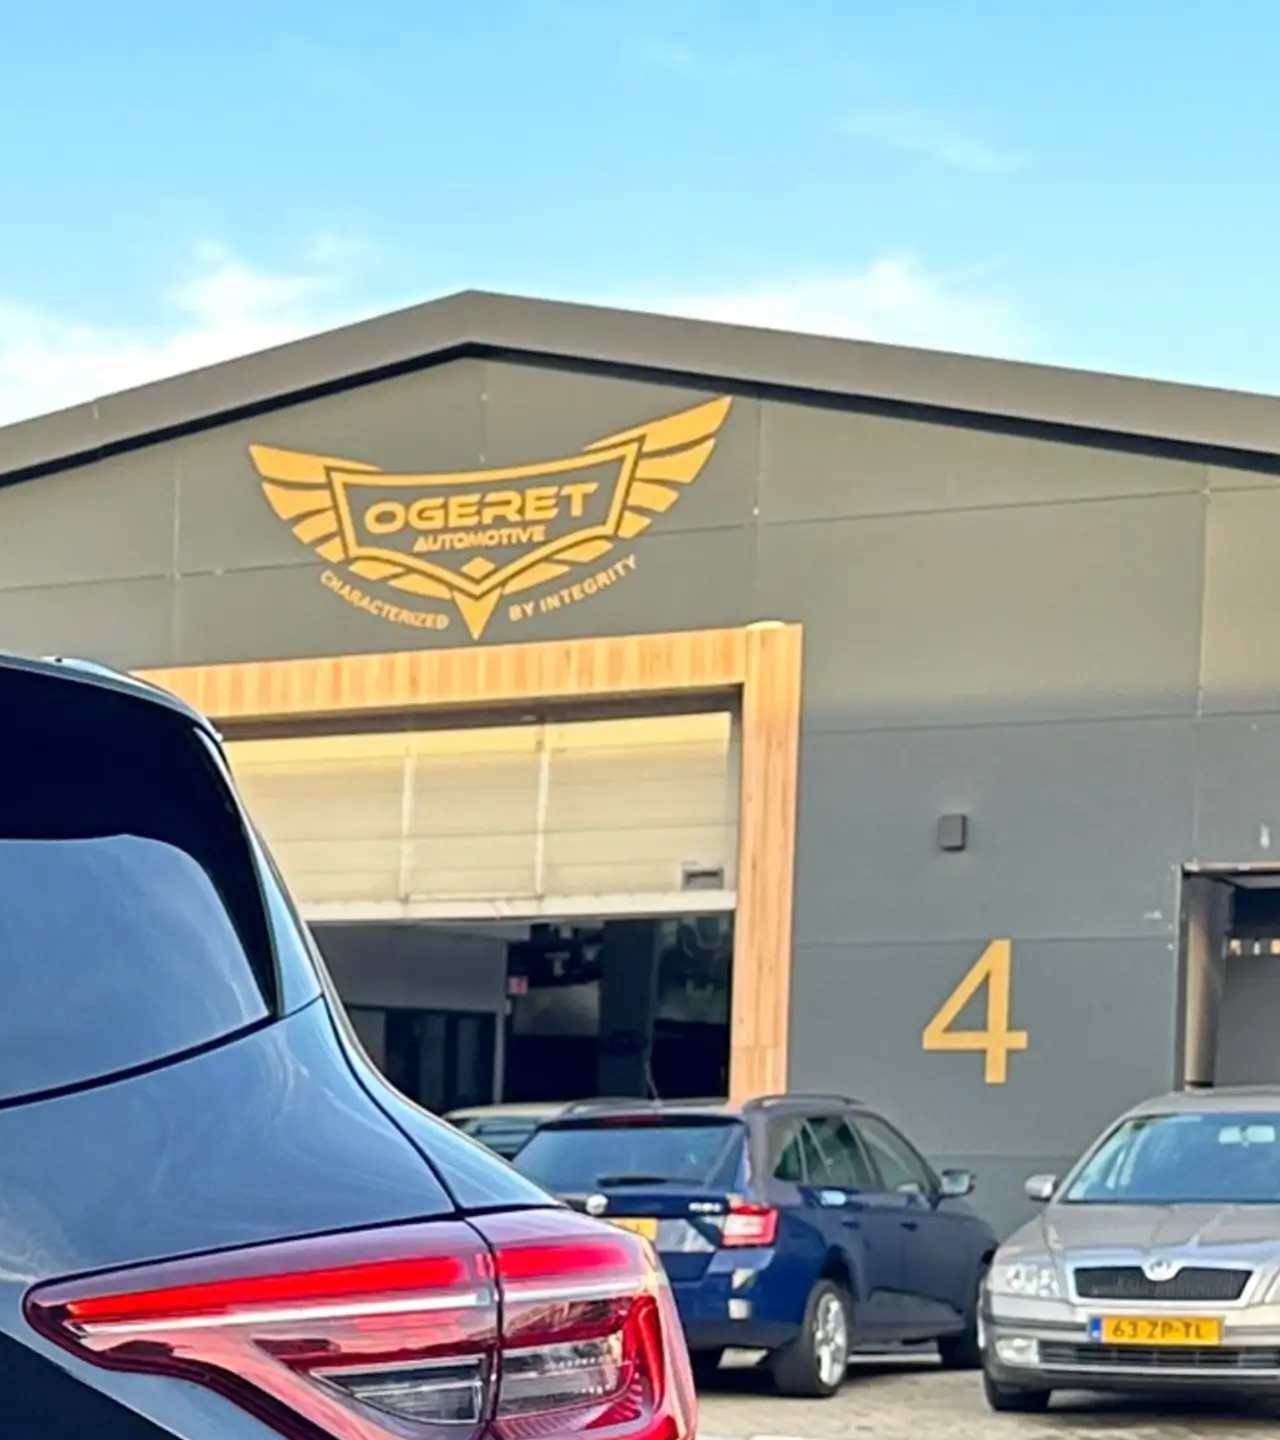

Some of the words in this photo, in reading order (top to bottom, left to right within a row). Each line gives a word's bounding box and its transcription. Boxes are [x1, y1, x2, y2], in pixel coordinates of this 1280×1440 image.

[364, 482, 600, 535] OGERET
[412, 525, 547, 553] AUTOMOTIVE
[319, 569, 450, 631] CHARACTERIZED
[508, 601, 535, 622] BY
[540, 553, 638, 612] INTEGRITY
[922, 938, 1028, 1084] 4
